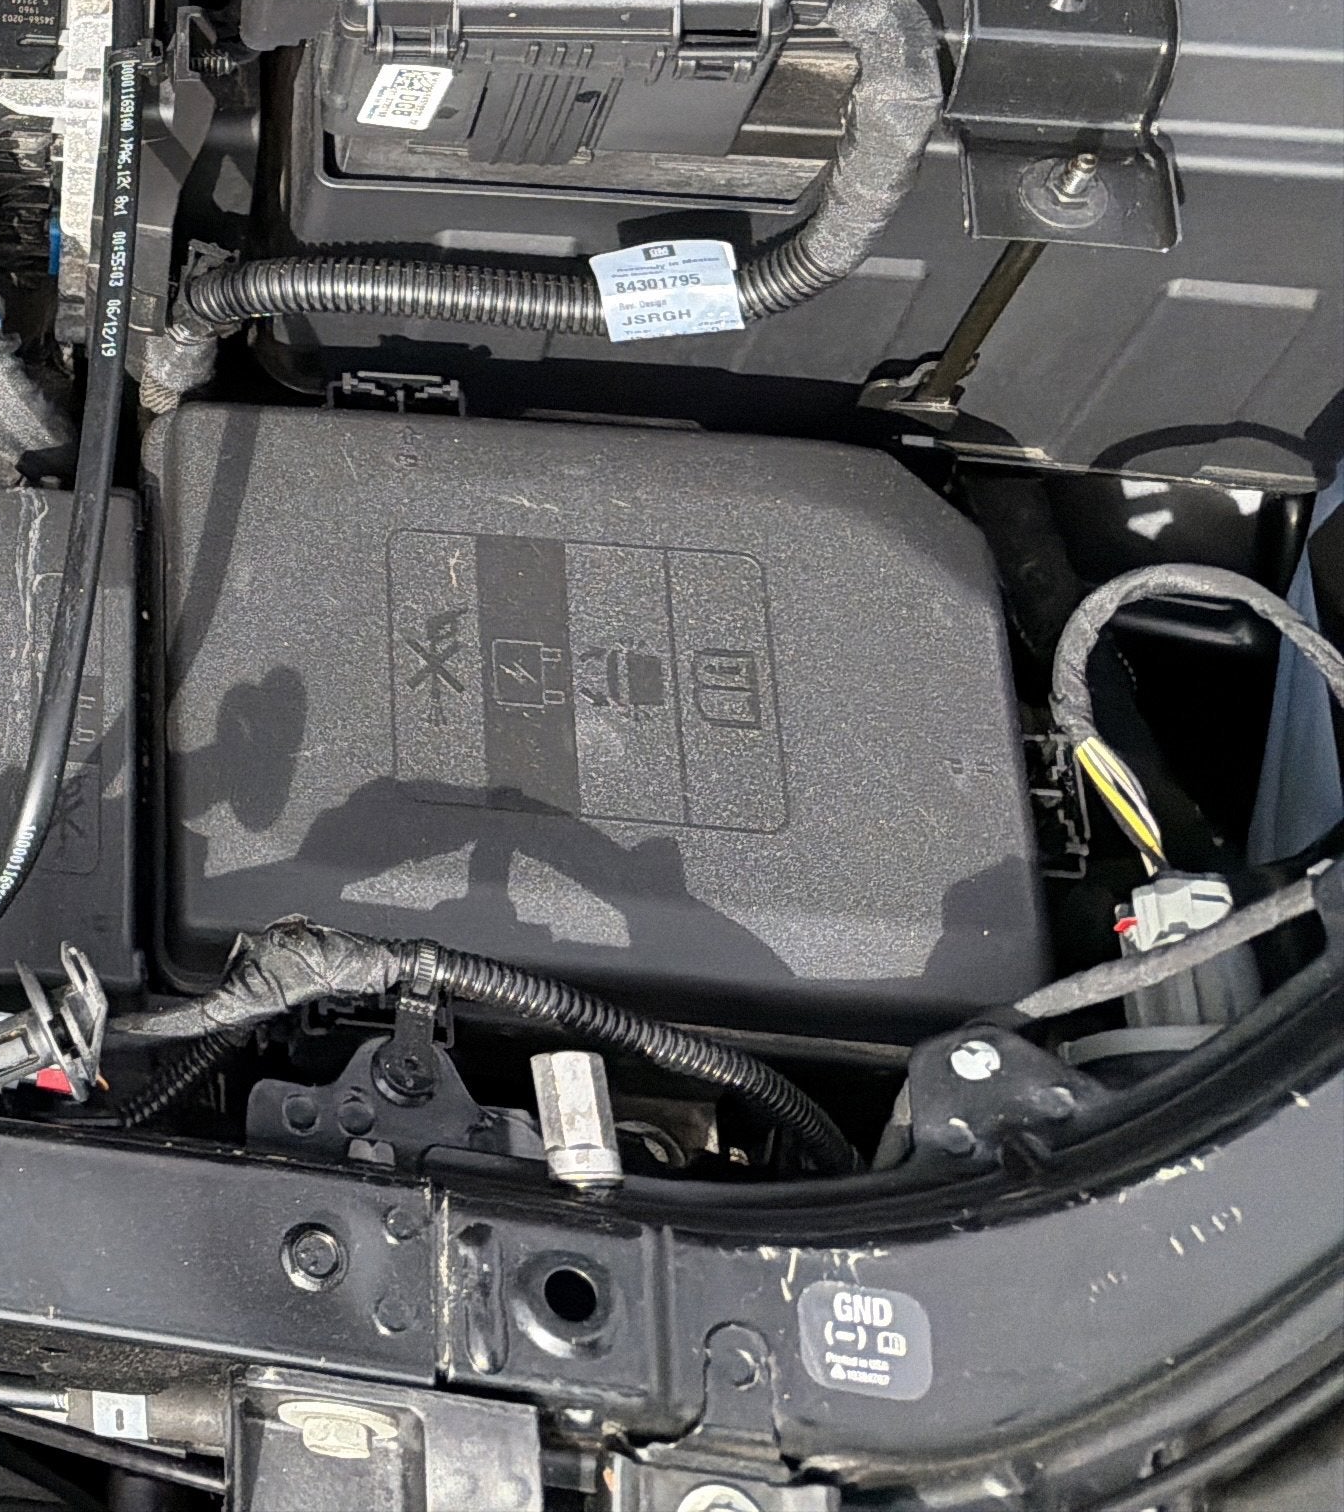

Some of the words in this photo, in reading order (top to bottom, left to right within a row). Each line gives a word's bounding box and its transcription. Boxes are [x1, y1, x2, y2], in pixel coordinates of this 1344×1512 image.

[114, 195, 129, 217] 8x1
[109, 231, 126, 288] 00:55:03
[614, 273, 702, 295] 84301795
[101, 299, 121, 358] 06/12/19
[621, 308, 692, 327] JSRGH
[833, 1291, 893, 1327] GND
